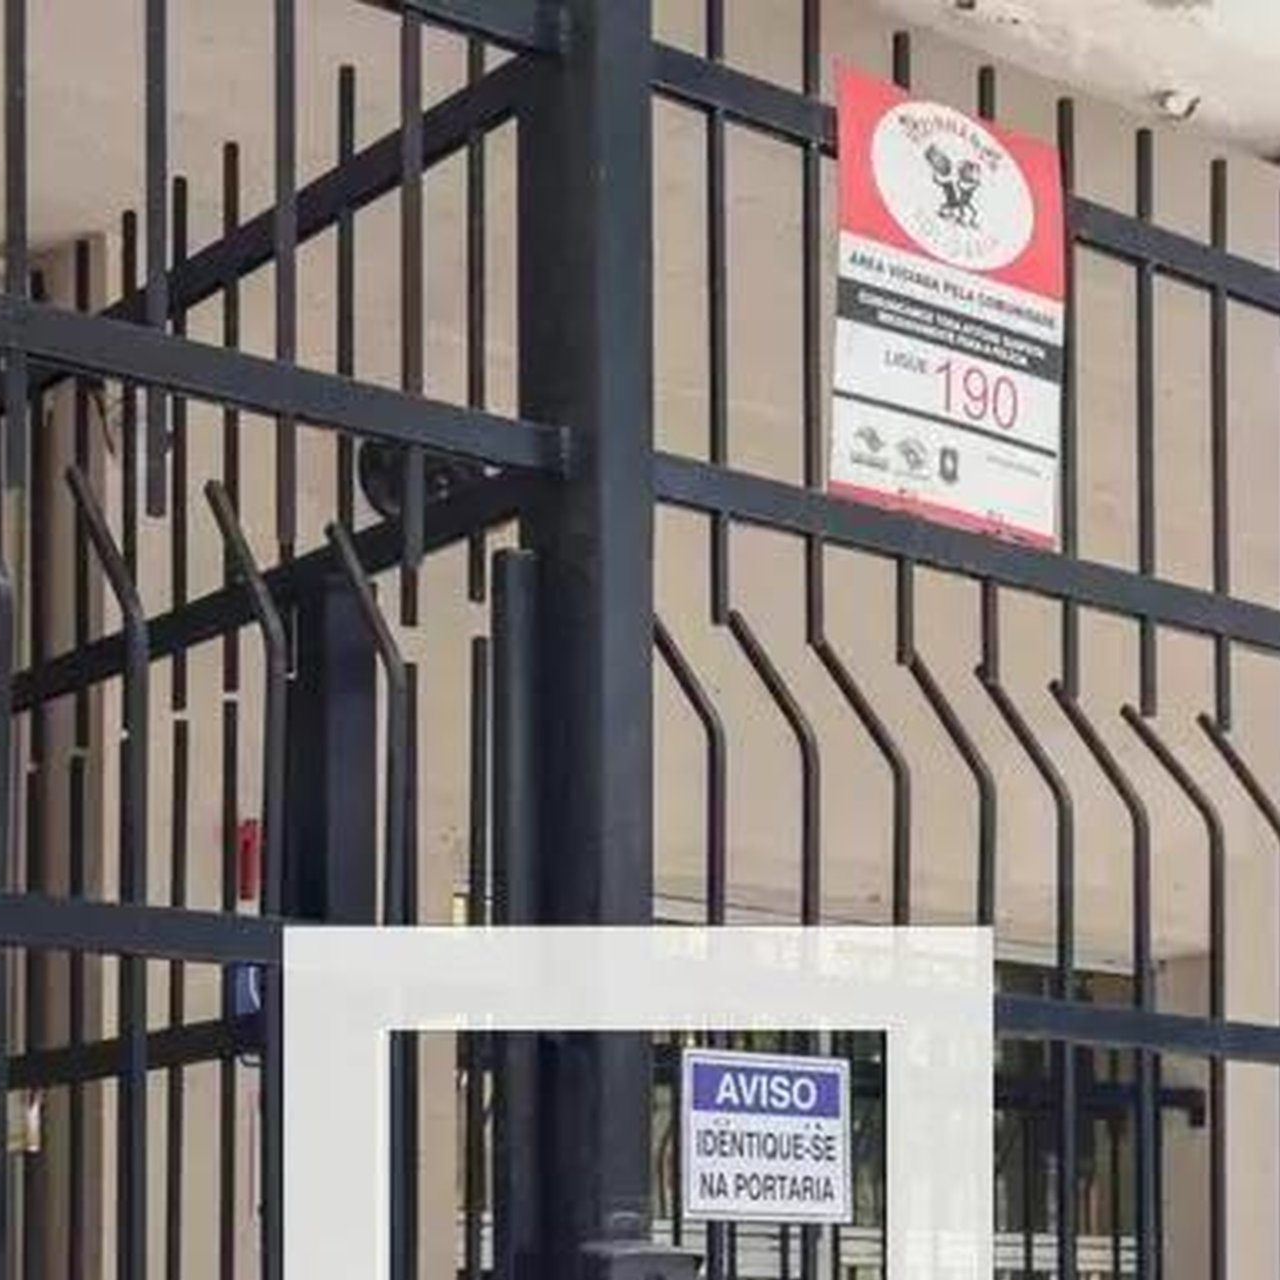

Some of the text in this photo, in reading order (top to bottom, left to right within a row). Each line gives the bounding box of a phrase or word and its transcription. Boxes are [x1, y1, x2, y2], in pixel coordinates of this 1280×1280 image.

[934, 360, 1018, 429] 190
[715, 1072, 817, 1110] AVISO
[696, 1129, 836, 1162] IDENTIQUE-SE
[699, 1172, 835, 1202] NA PORTARIA
